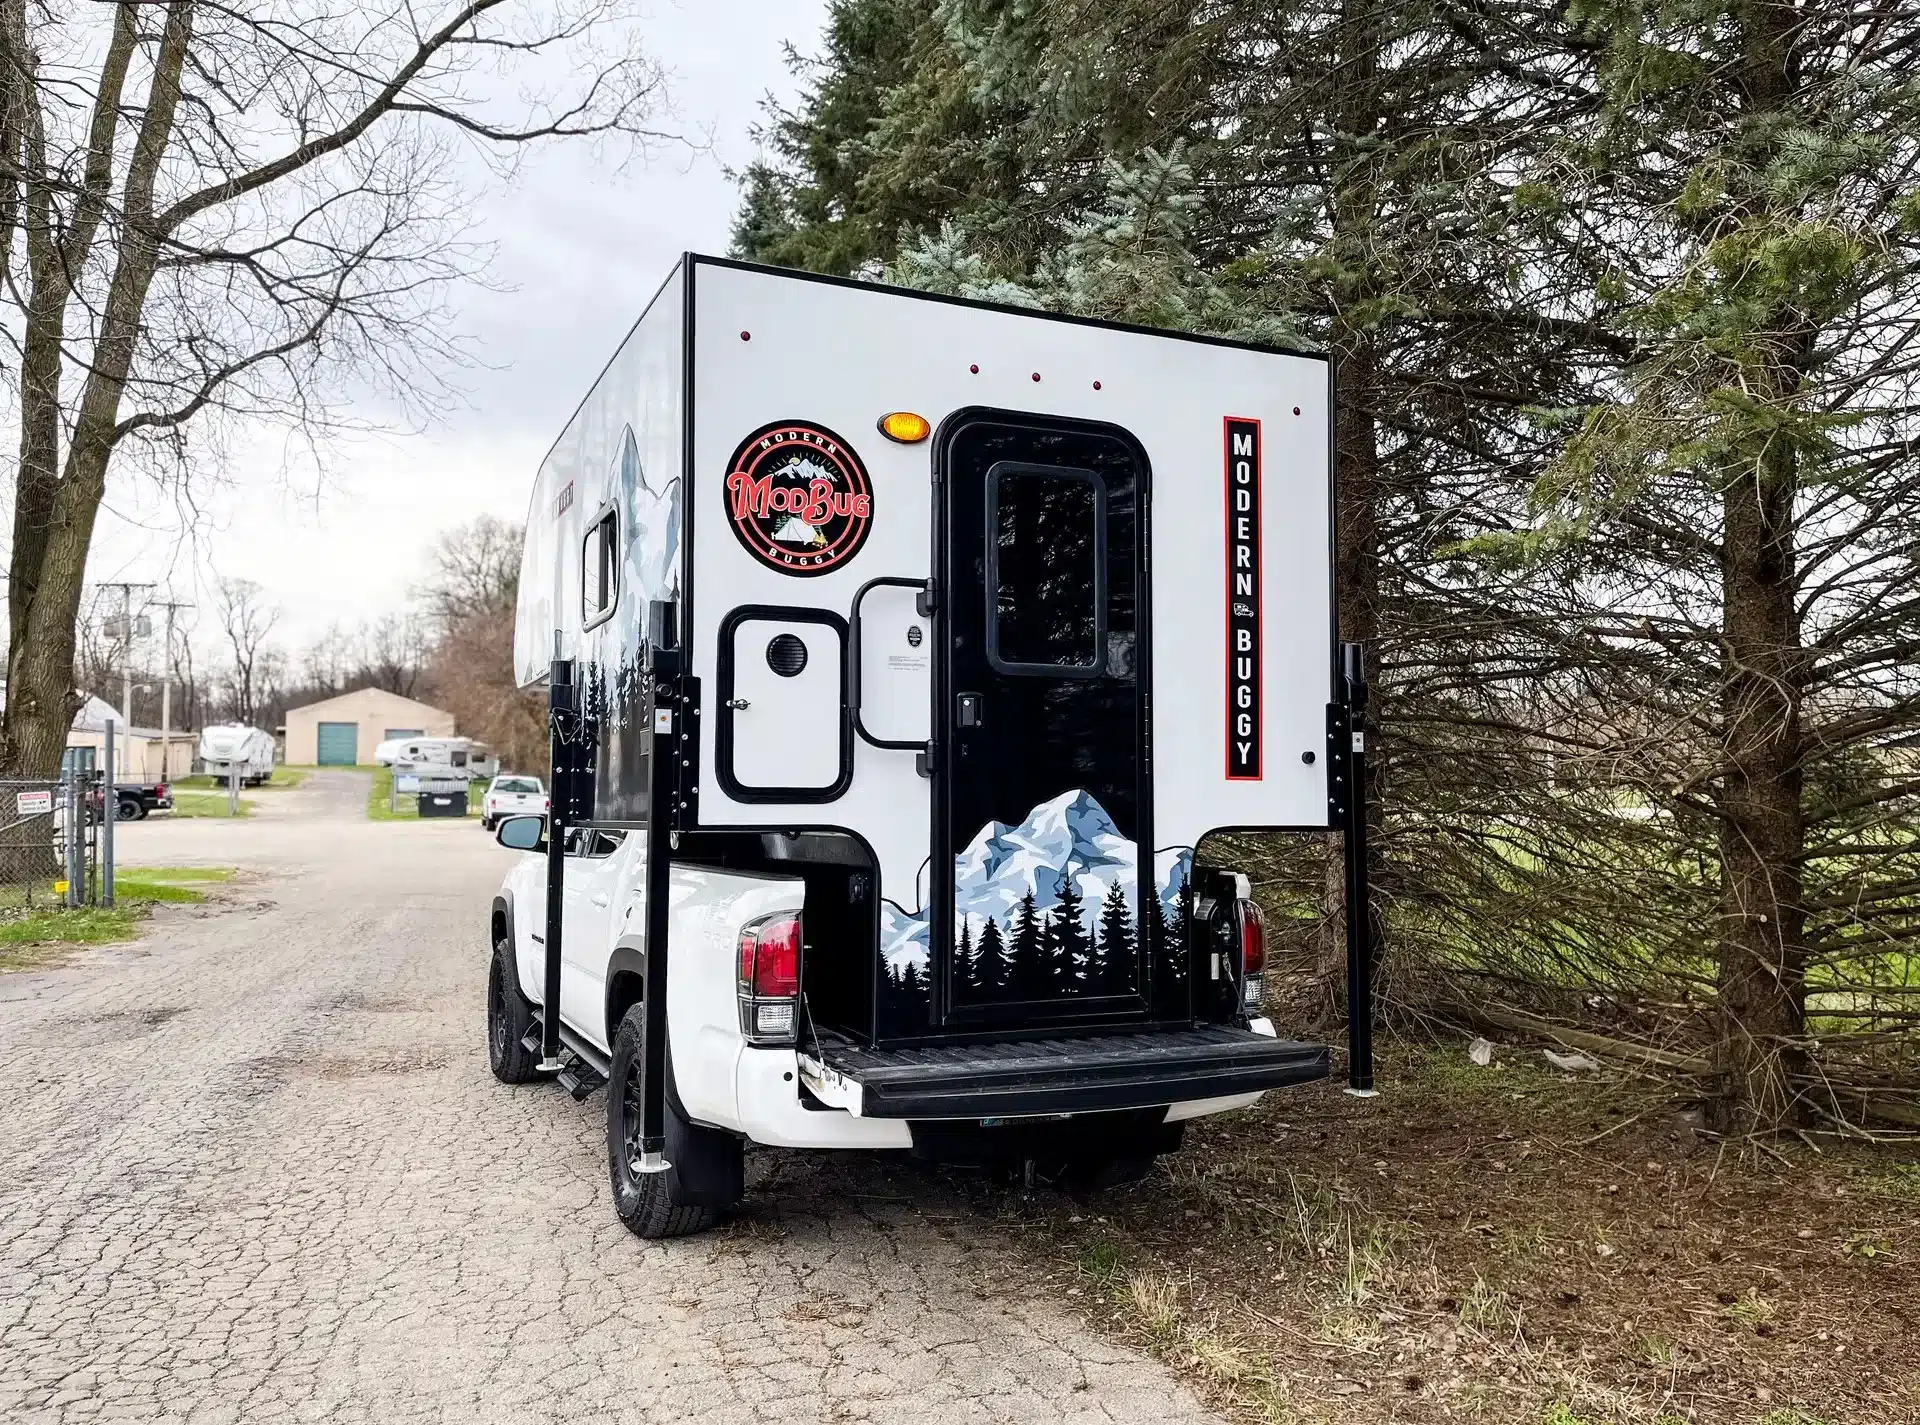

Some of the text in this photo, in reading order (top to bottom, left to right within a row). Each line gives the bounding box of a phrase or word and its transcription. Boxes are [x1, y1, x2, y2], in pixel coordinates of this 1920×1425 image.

[760, 431, 838, 454] MODERN
[768, 547, 838, 566] BUGGY
[1233, 433, 1252, 765] MODERN BUGGY
